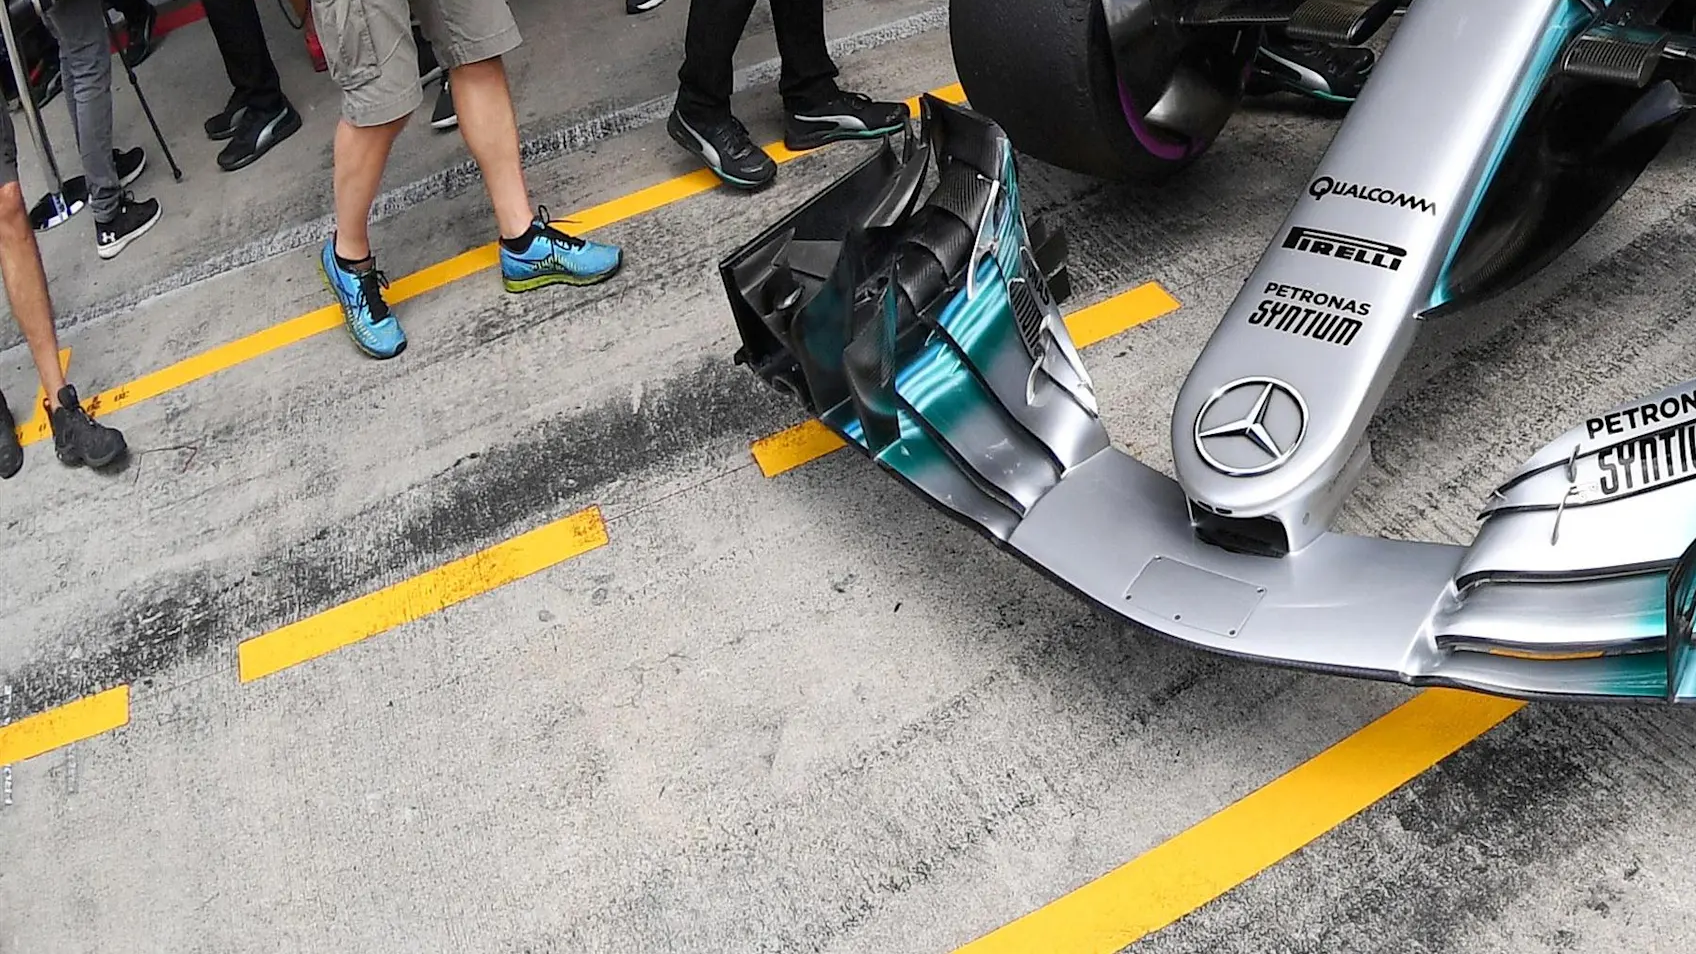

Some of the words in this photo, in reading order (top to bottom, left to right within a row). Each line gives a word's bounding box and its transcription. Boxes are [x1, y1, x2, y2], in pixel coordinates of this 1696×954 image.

[1281, 226, 1408, 271] PIRELLI
[1263, 282, 1371, 316] PETRONAS
[1248, 299, 1363, 346] SYNTIUM
